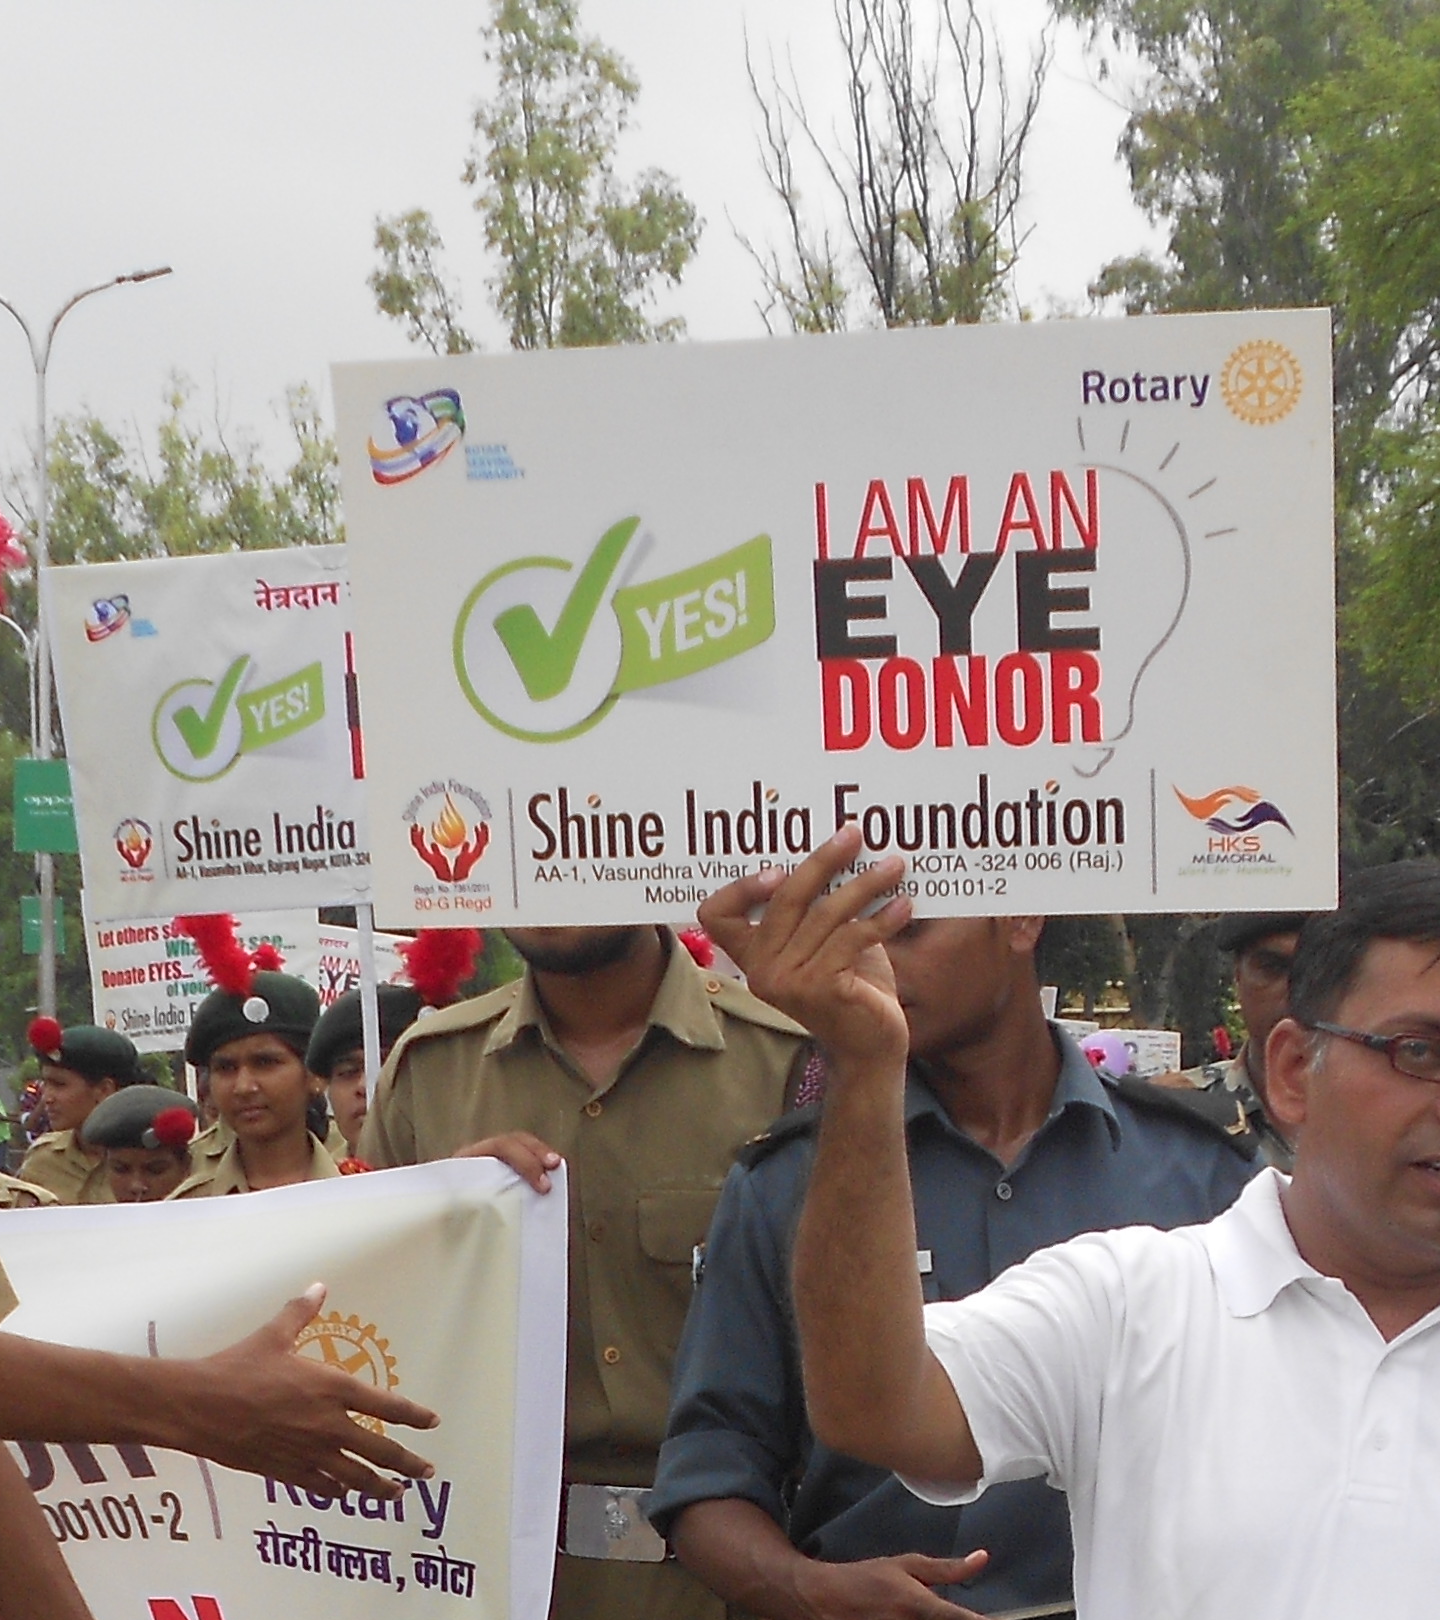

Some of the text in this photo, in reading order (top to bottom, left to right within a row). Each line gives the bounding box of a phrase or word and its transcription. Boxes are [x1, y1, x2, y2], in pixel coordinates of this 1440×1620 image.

[1081, 369, 1210, 407] Rotary
[813, 468, 1099, 560] I AM AN
[254, 578, 340, 611] नेत्रदान
[812, 547, 1101, 661] EYE
[636, 570, 748, 660] YES!
[248, 682, 310, 733] YES!
[820, 649, 1104, 752] DONOR
[527, 773, 1126, 861] Shine India Foundation
[172, 804, 356, 862] Shine India
[1208, 836, 1261, 852] HKS
[534, 865, 587, 883] AA-1,
[592, 862, 693, 882] Vasundhra
[912, 852, 968, 873] KOTA
[1025, 851, 1062, 871] 006
[1069, 850, 1125, 874] (Raj.)
[1192, 853, 1277, 864] MEMORIAL
[925, 877, 1008, 899] 00101-2
[454, 896, 492, 912] Regd
[98, 929, 114, 948] Let
[117, 926, 159, 946] others
[165, 939, 200, 958] Wha
[102, 966, 145, 988] Donate
[122, 1007, 151, 1031] Shine
[154, 1002, 185, 1027] India
[253, 1520, 323, 1574] रोटरी
[410, 1544, 477, 1599] कोटा
